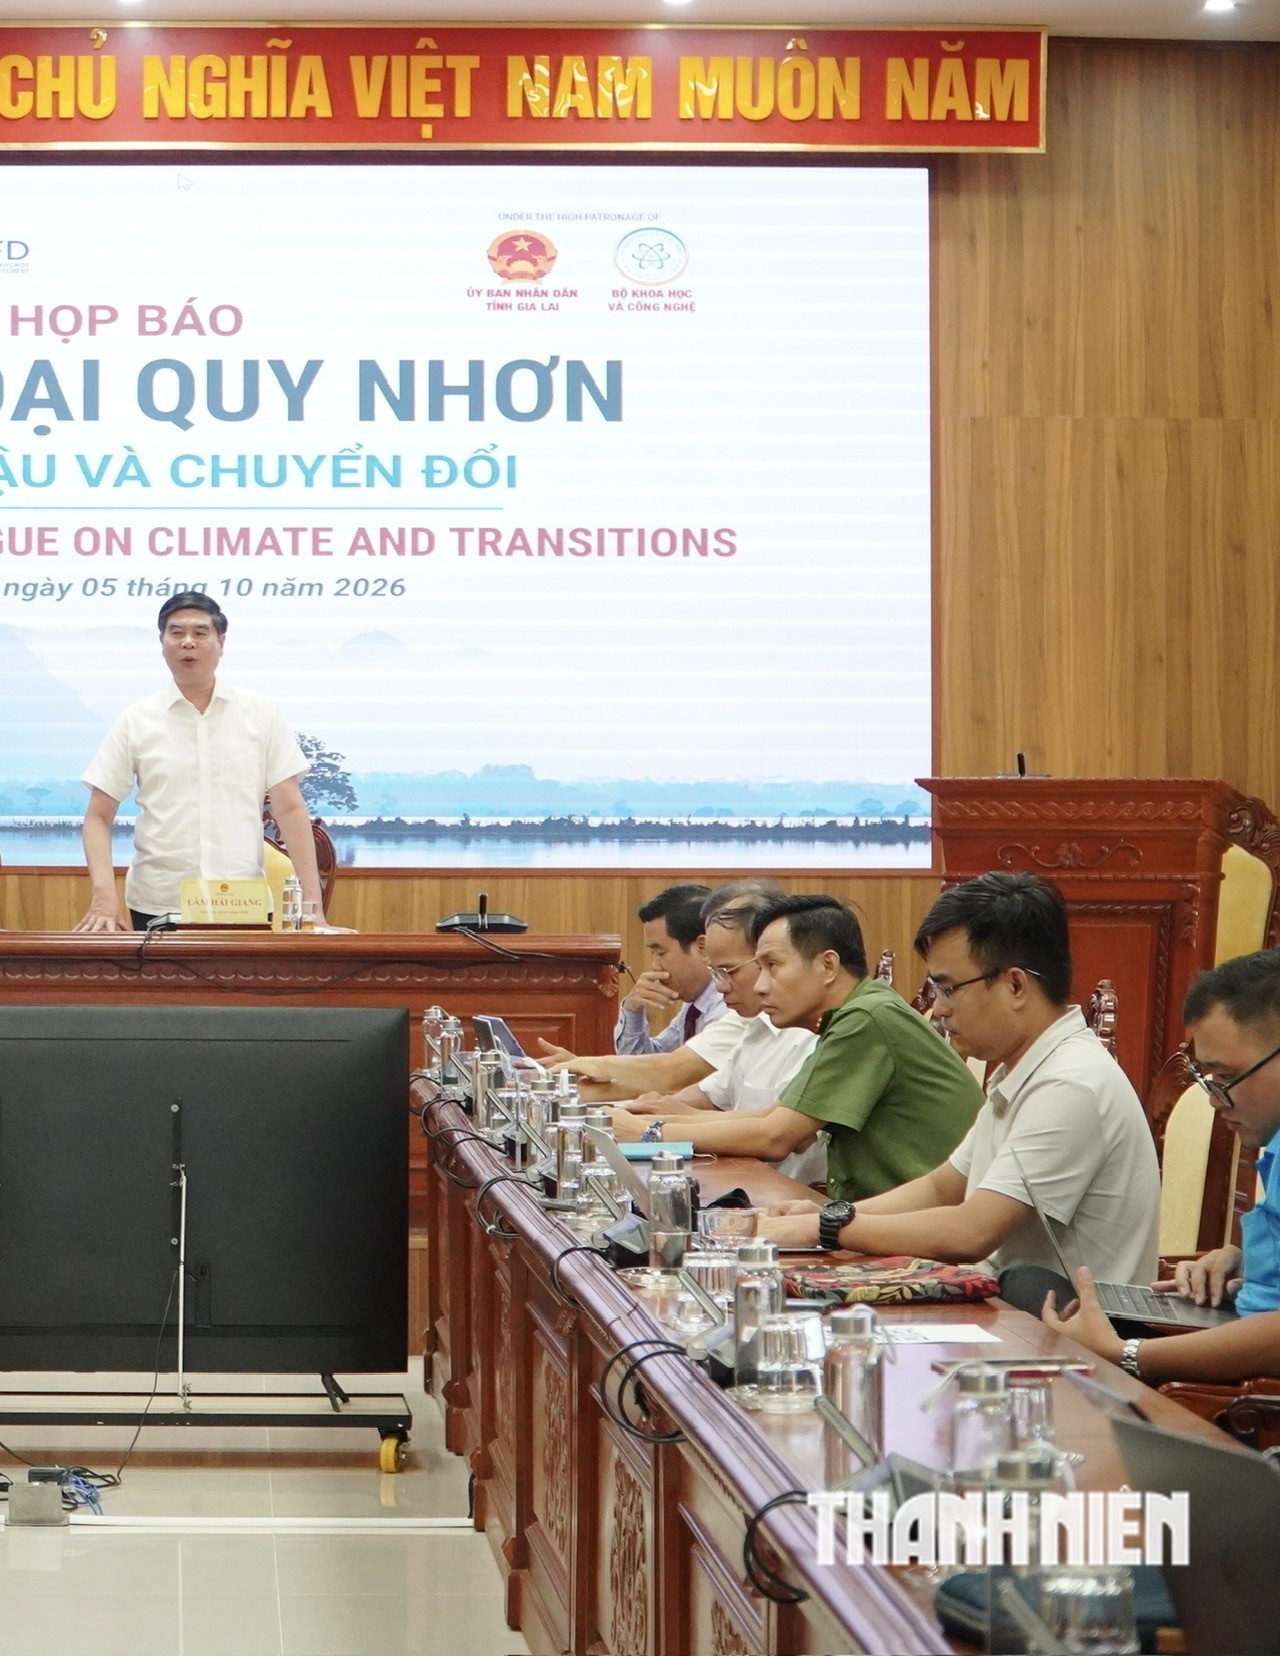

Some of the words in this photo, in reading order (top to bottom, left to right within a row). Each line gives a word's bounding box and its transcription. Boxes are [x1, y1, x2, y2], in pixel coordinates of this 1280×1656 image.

[142, 38, 332, 119] NGHĨA
[350, 38, 479, 138] VIỆT
[507, 55, 652, 120] NAM
[677, 38, 860, 120] MUÔN
[886, 40, 1029, 121] NĂM
[497, 212, 532, 222] UNDER
[535, 212, 554, 222] THE
[557, 212, 583, 222] HIGH
[584, 212, 643, 222] PATRONAGE
[647, 212, 661, 222] OF
[486, 288, 512, 298] BAN
[515, 287, 550, 298] NHÂN
[552, 287, 578, 298] DÂN
[631, 289, 664, 298] KHOA
[516, 302, 538, 311] GIA
[540, 302, 560, 311] LAI
[627, 300, 661, 312] CÔNG
[10, 304, 119, 344] HỌP
[137, 297, 244, 337] BÁO
[137, 358, 324, 431] QUY
[359, 355, 623, 423] NHƠN
[75, 446, 151, 488] VÀ
[170, 443, 402, 489] CHUYỂN
[421, 443, 517, 489] ĐỔI
[73, 526, 132, 557] ON
[148, 526, 334, 557] CLIMATE
[347, 526, 436, 557] AND
[449, 527, 738, 558] TRANSITIONS
[3, 577, 74, 602] ngày
[81, 577, 118, 597] 05
[220, 577, 254, 597] 10
[261, 577, 324, 597] năm
[333, 577, 407, 597] 2026
[230, 898, 263, 907] GIANG
